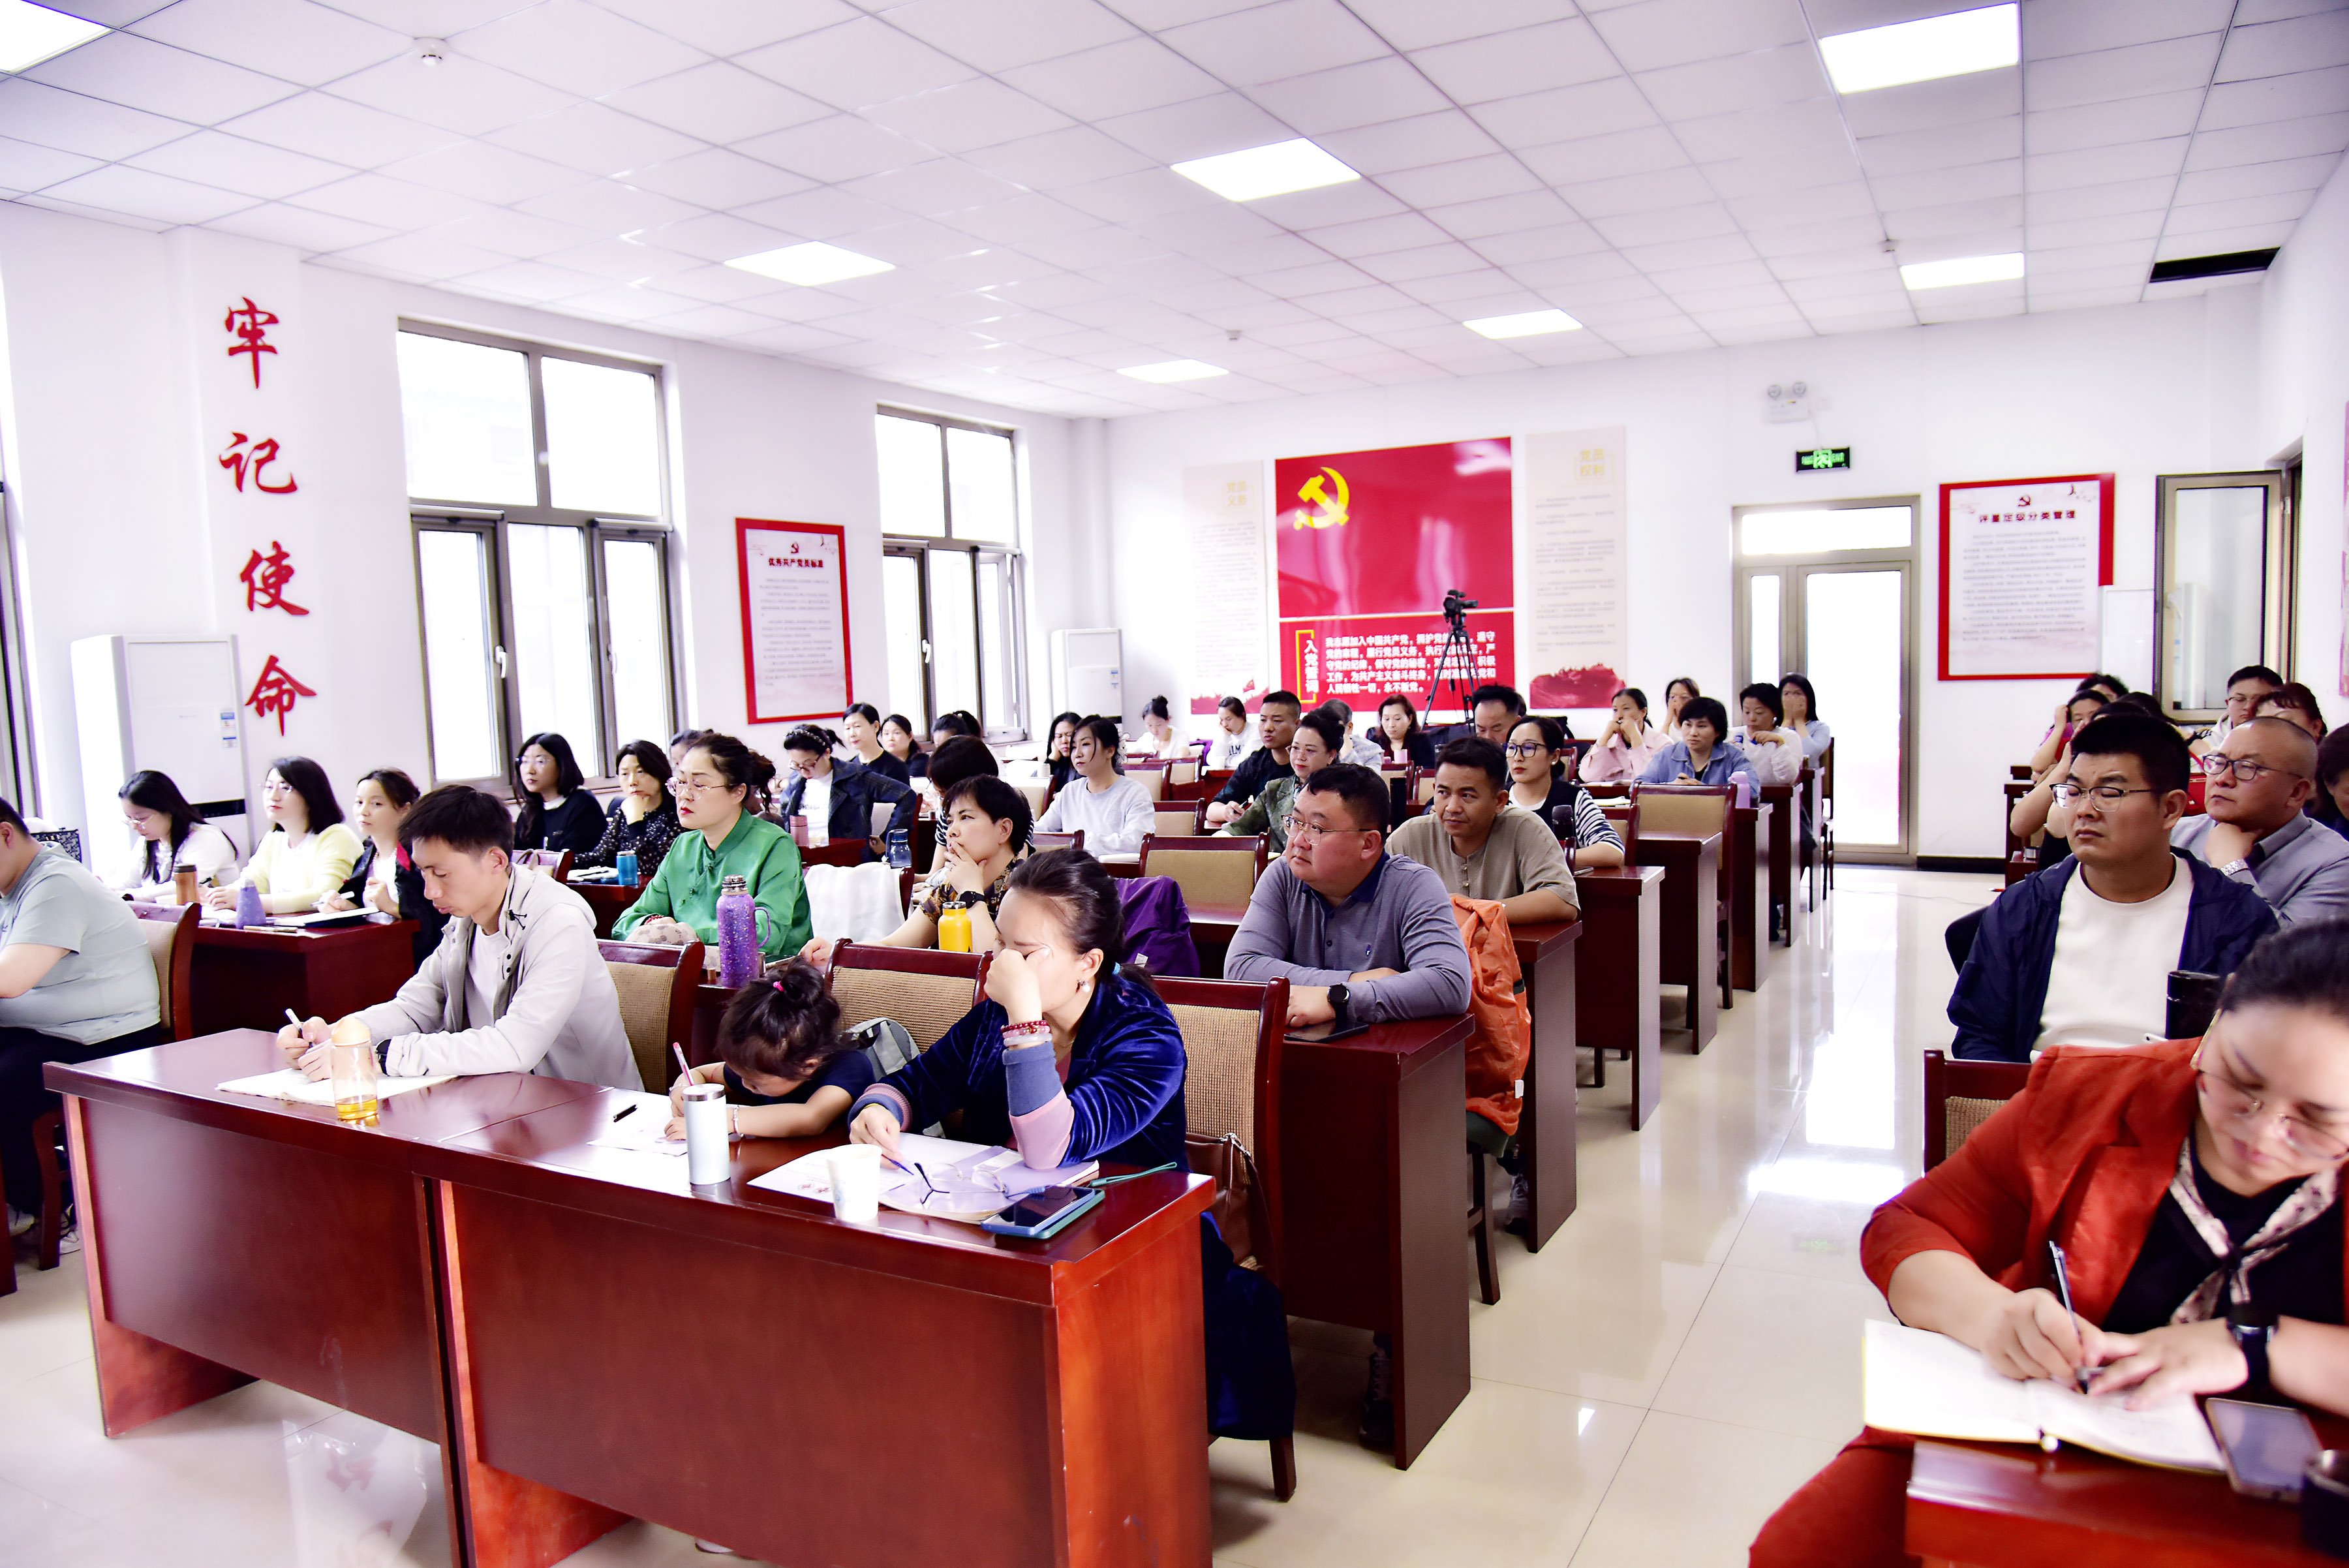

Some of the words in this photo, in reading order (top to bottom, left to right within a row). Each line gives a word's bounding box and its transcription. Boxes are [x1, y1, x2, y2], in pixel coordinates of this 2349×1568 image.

[219, 297, 316, 737] 牢记使命
[1304, 639, 1319, 694] 入党誓词
